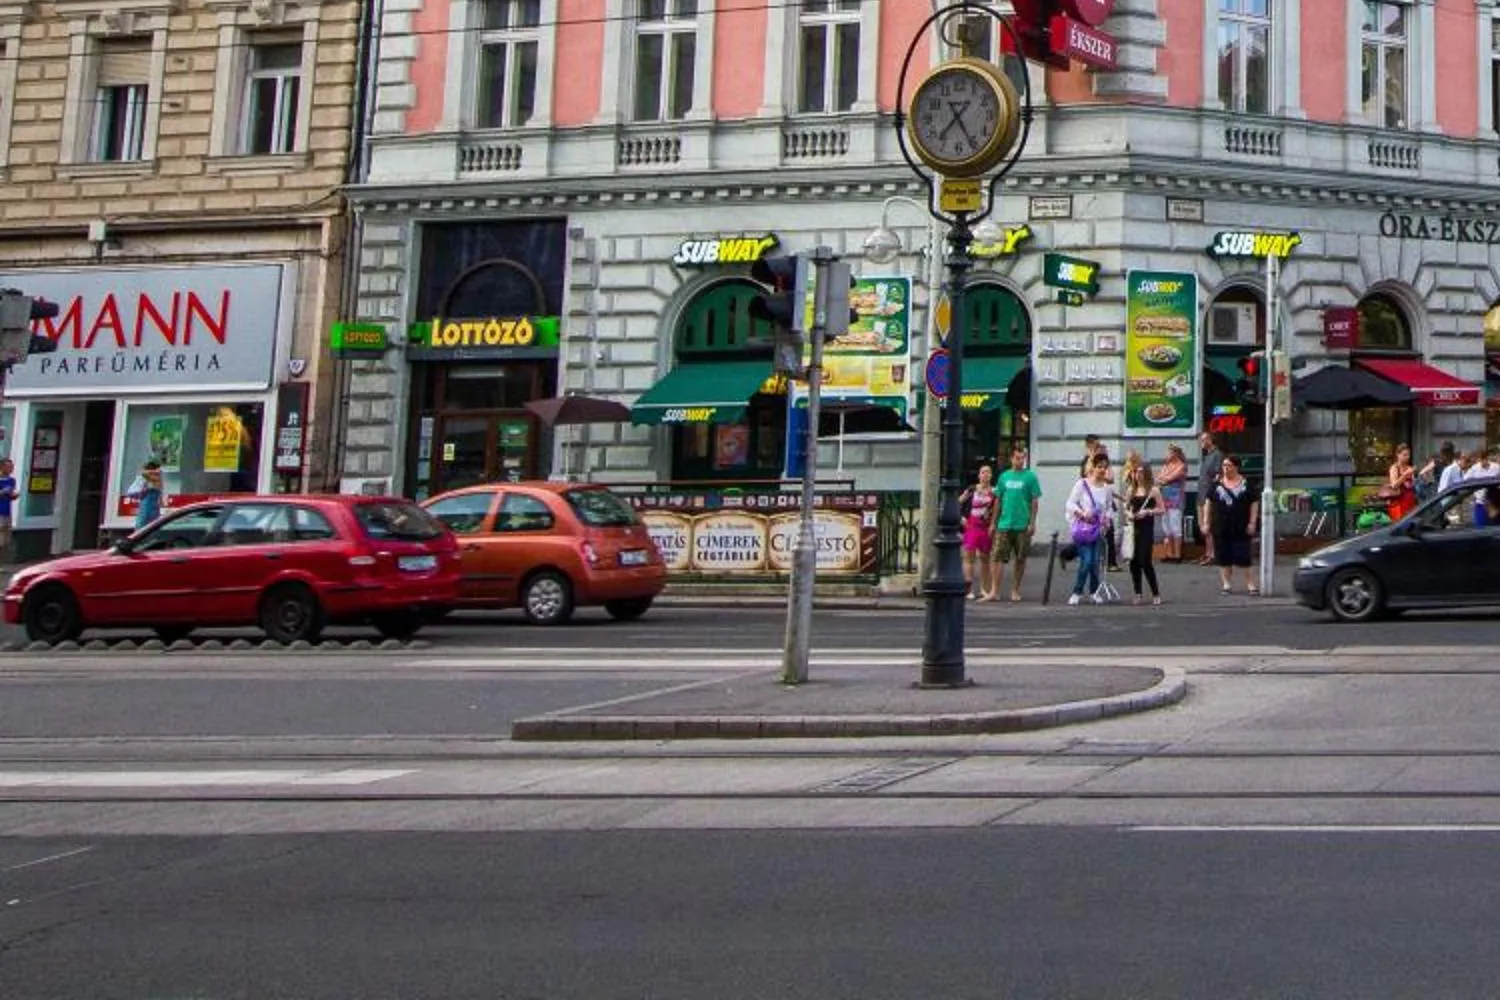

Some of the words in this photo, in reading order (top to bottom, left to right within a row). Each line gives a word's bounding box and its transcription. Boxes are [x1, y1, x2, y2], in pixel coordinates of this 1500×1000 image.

[1069, 23, 1112, 61] ÉKSZER
[674, 236, 776, 263] SUBWAY
[1213, 232, 1301, 257] SUBWAY
[431, 316, 534, 347] LOTTÓZÓ
[662, 408, 717, 422] SUBWAY
[696, 532, 762, 549] CÍMEREK
[770, 533, 857, 553] CÍESTŐ
